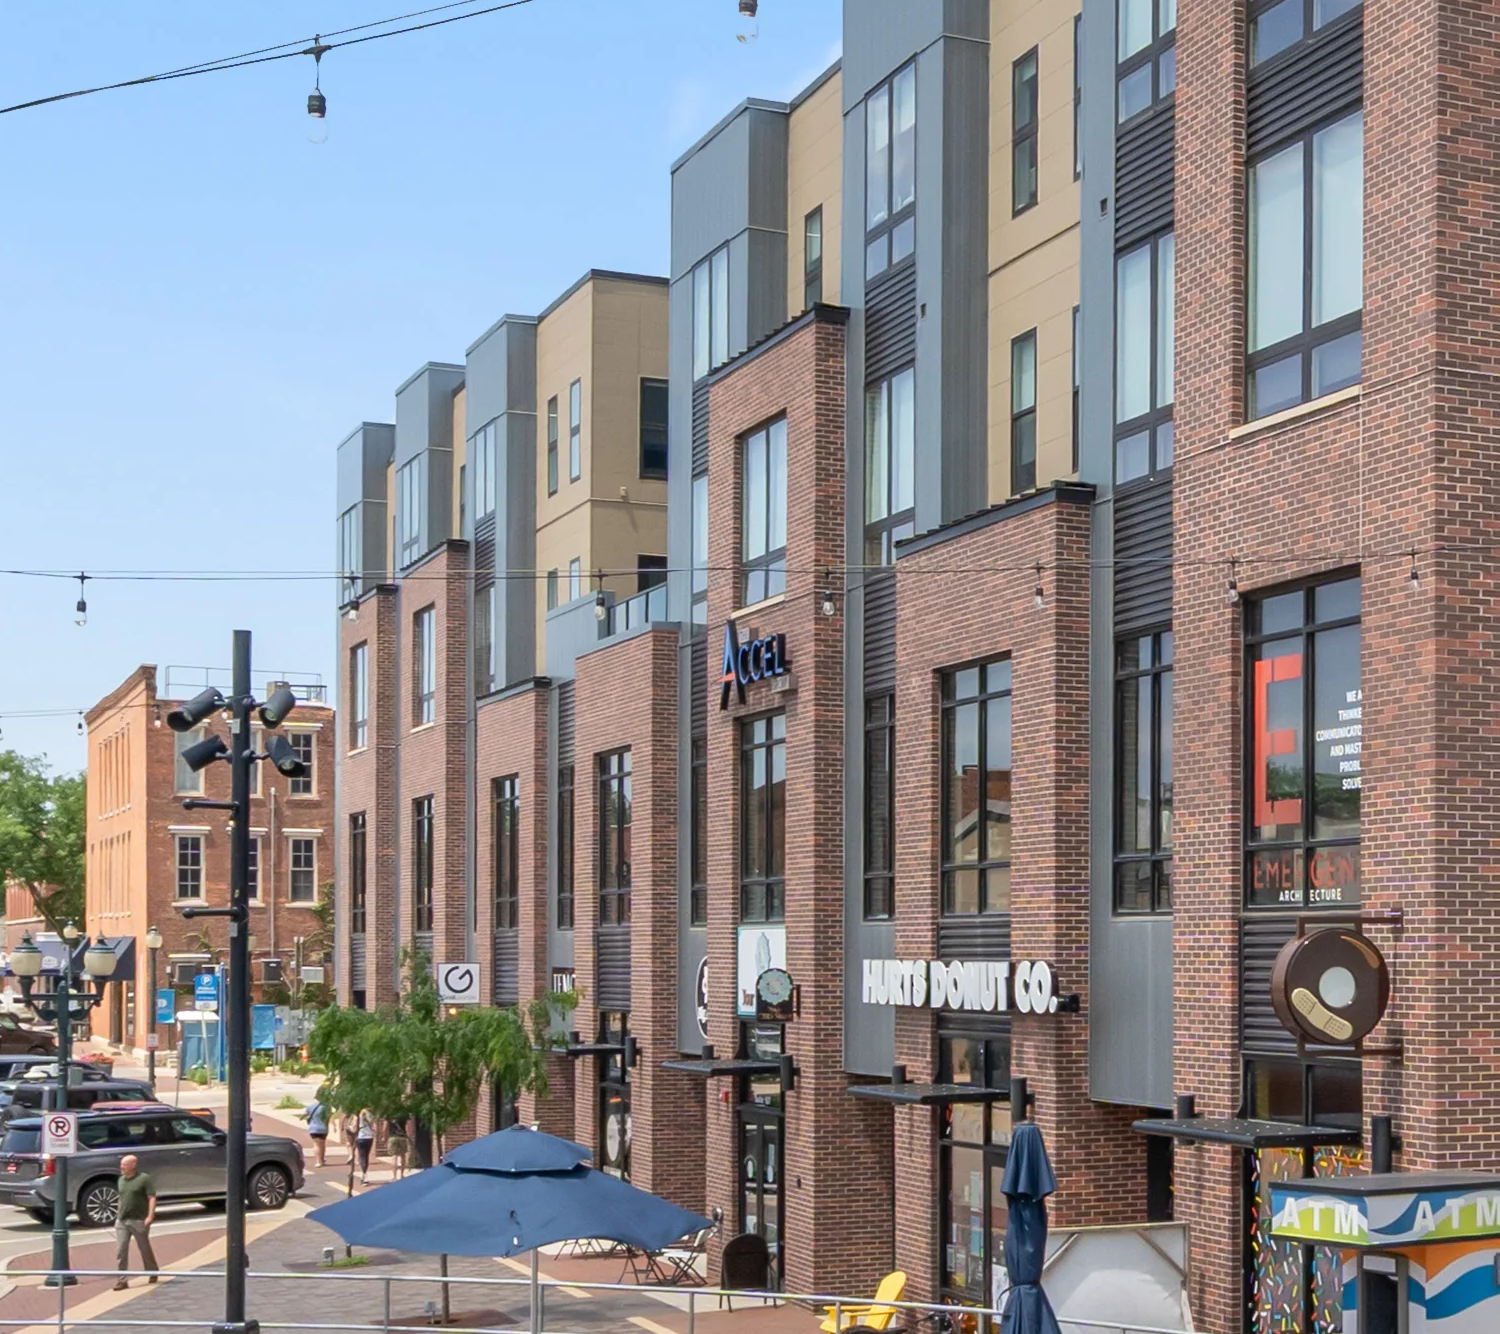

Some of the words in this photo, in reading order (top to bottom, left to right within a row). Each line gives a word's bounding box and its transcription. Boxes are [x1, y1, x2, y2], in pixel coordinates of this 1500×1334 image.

[716, 620, 789, 710] ACCEL
[1346, 690, 1357, 703] WE
[1330, 745, 1344, 757] AND
[1279, 887, 1342, 902] ARCHIECTURE
[862, 958, 927, 1008] HURTS
[930, 959, 1011, 1012] DONUT
[1014, 960, 1058, 1014] CO.
[1280, 1196, 1360, 1238] ATM
